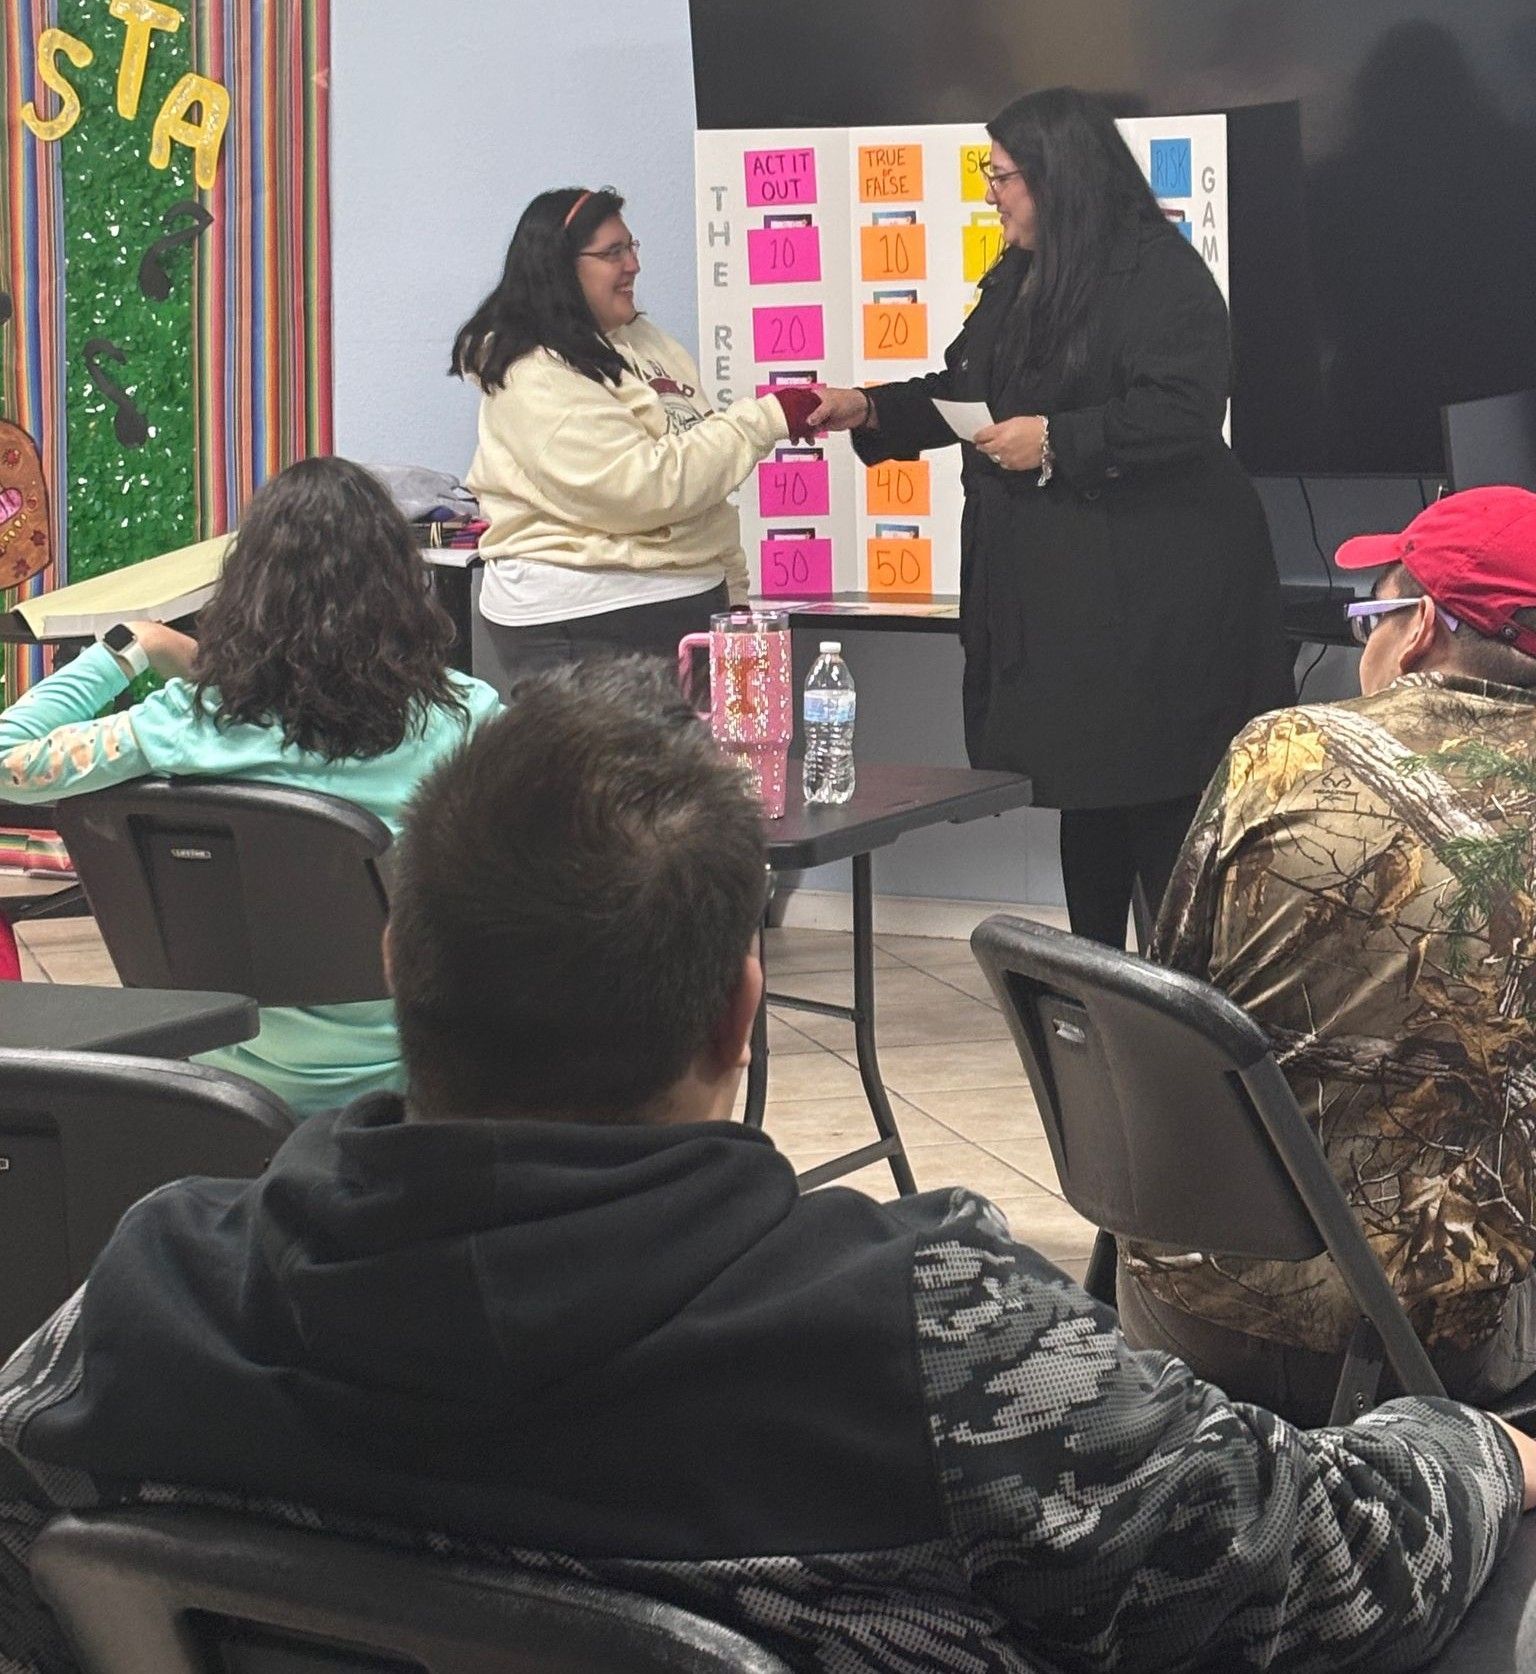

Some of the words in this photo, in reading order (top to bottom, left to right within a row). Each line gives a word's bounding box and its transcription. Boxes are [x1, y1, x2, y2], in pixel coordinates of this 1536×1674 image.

[753, 154, 786, 176] ACT
[792, 152, 811, 174] IT
[865, 147, 907, 168] TRUE
[882, 167, 893, 178] or
[966, 150, 990, 174] SK
[1156, 146, 1188, 189] RISK
[761, 178, 802, 201] OUT
[865, 175, 910, 198] FALSE
[1201, 165, 1219, 263] GAM
[708, 186, 731, 287] THE
[770, 236, 796, 270] 10
[879, 232, 910, 274] 10
[770, 315, 806, 354] 20
[878, 312, 909, 350] 20
[714, 324, 735, 413] RES
[774, 471, 808, 506] 40
[876, 468, 914, 505] 40
[773, 549, 809, 587] 50
[876, 548, 921, 587] 50
